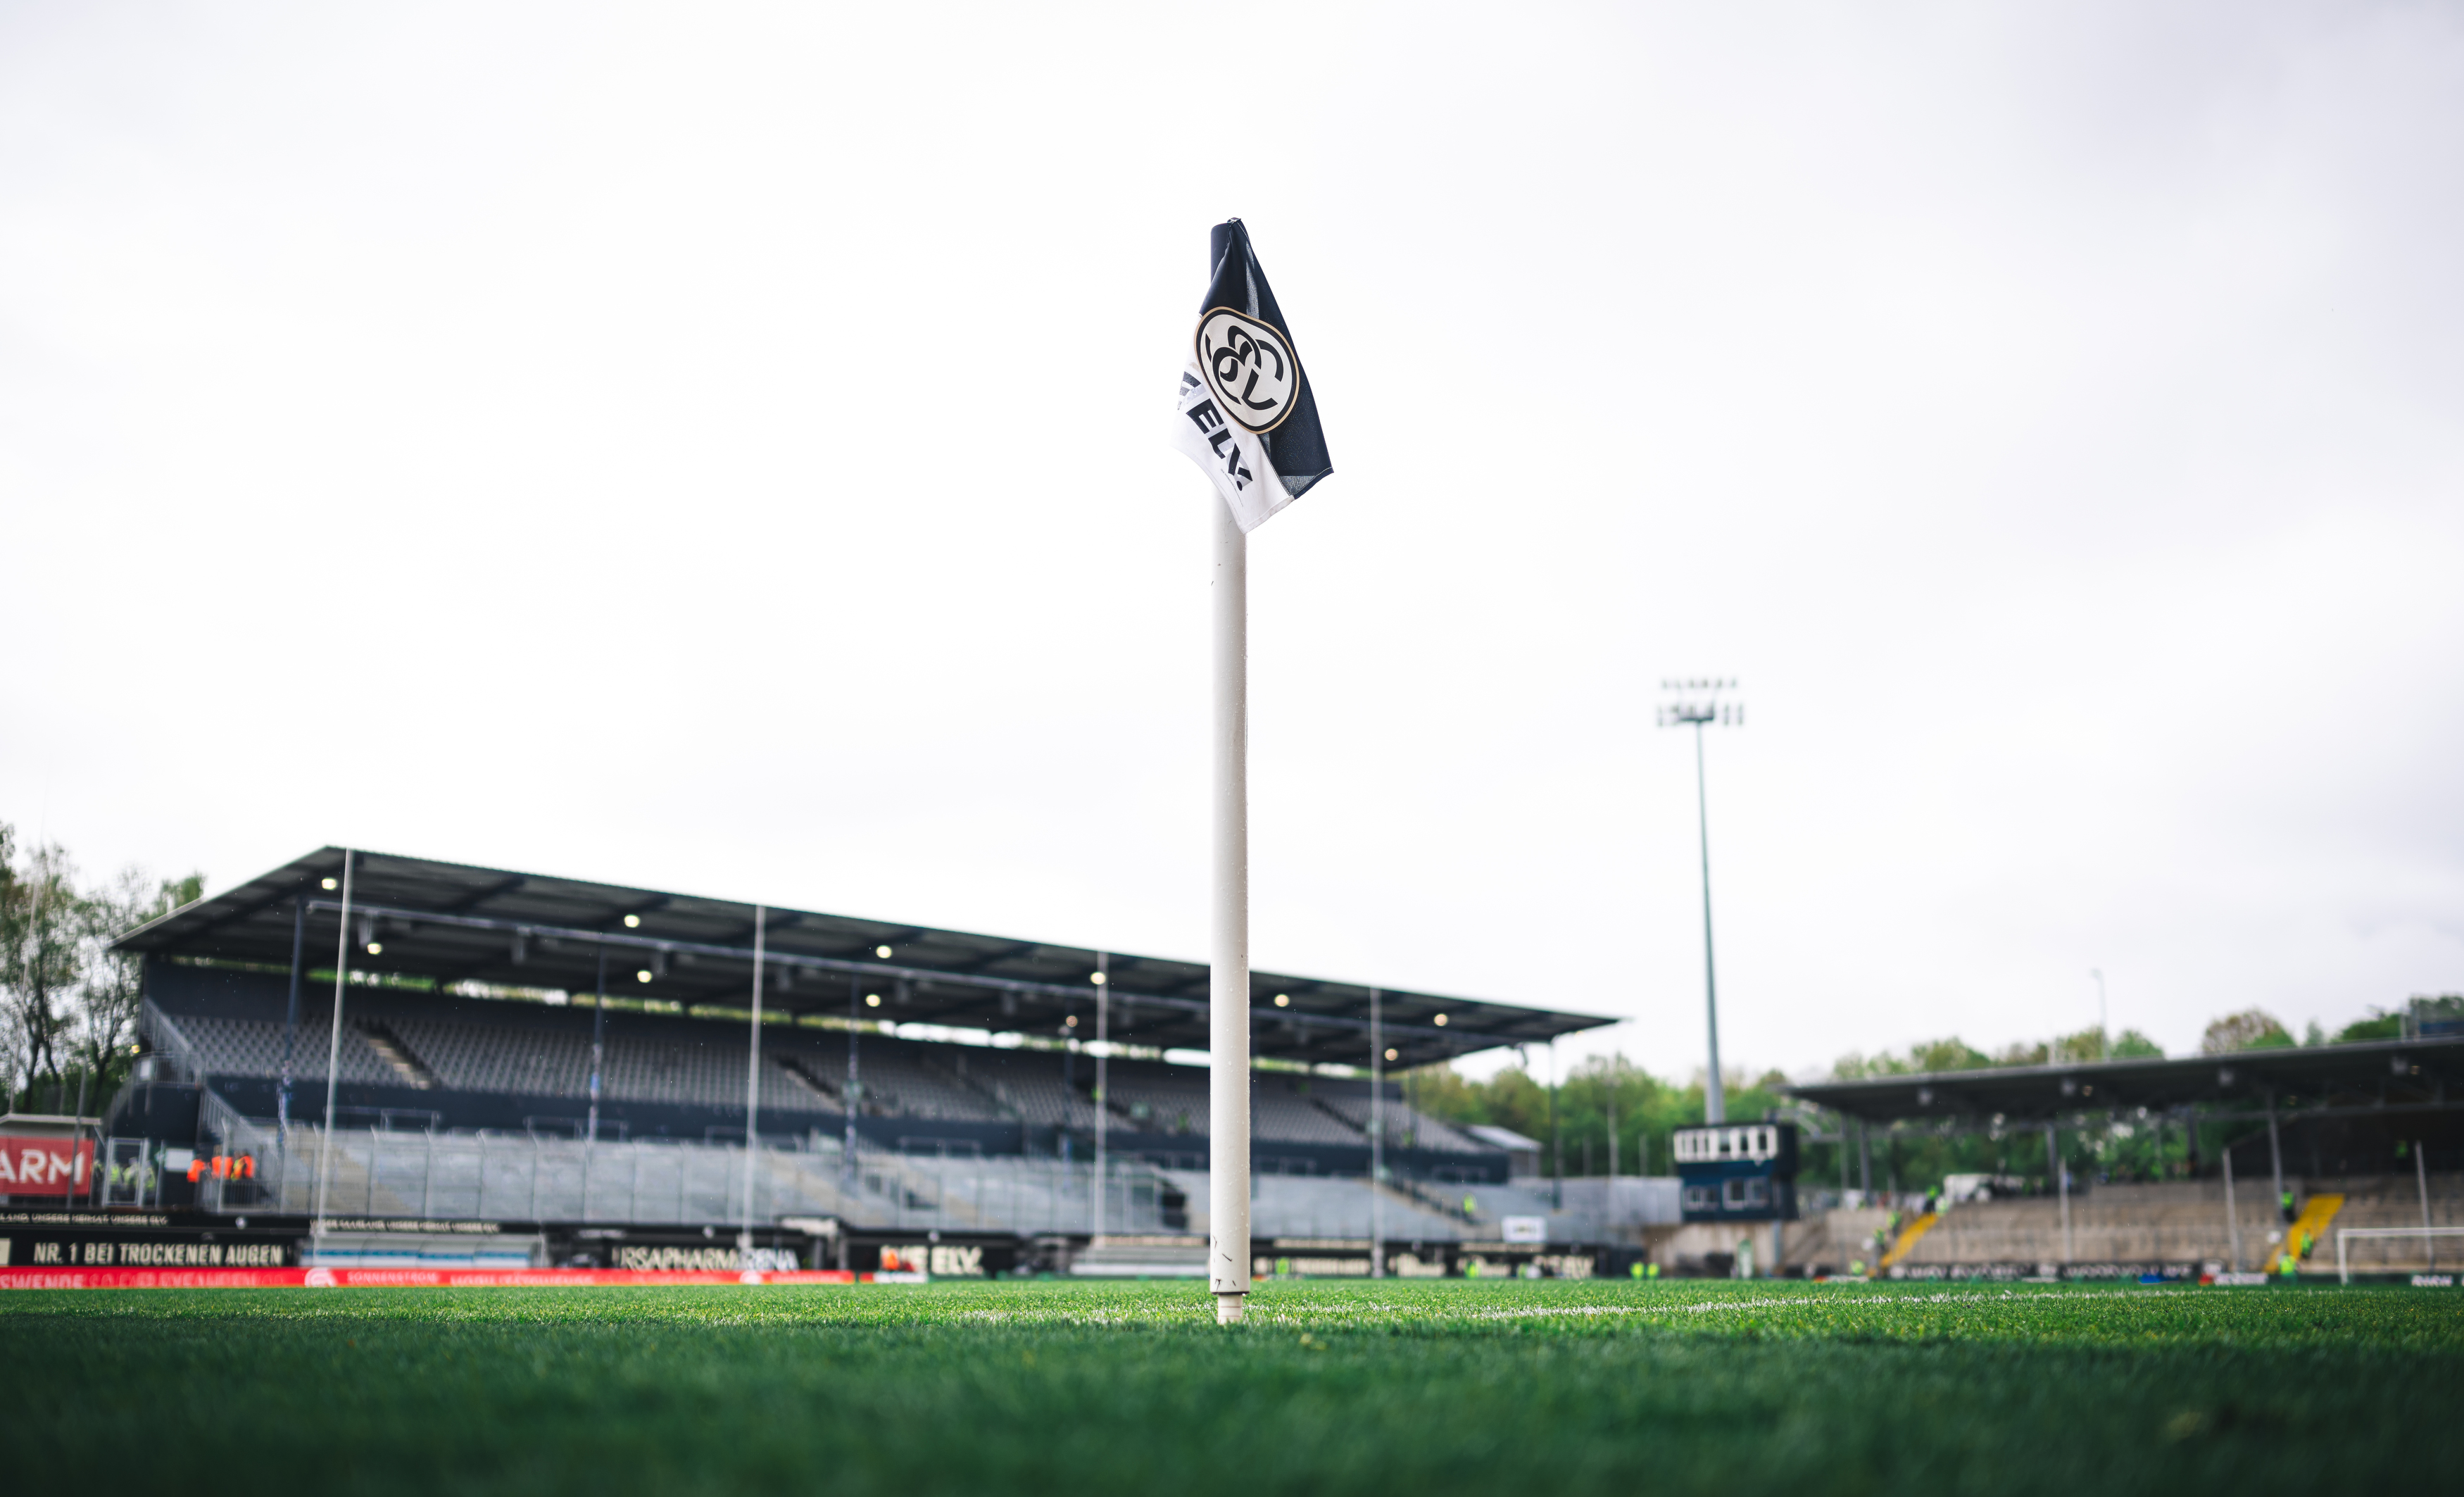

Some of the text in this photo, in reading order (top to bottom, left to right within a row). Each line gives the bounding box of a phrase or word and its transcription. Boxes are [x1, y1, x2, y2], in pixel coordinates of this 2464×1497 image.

[32, 1213, 69, 1224] UNSERE
[111, 1215, 148, 1225] UNSERE
[34, 1242, 283, 1266] NR. 1 BEI TROCKENEN AUGEN
